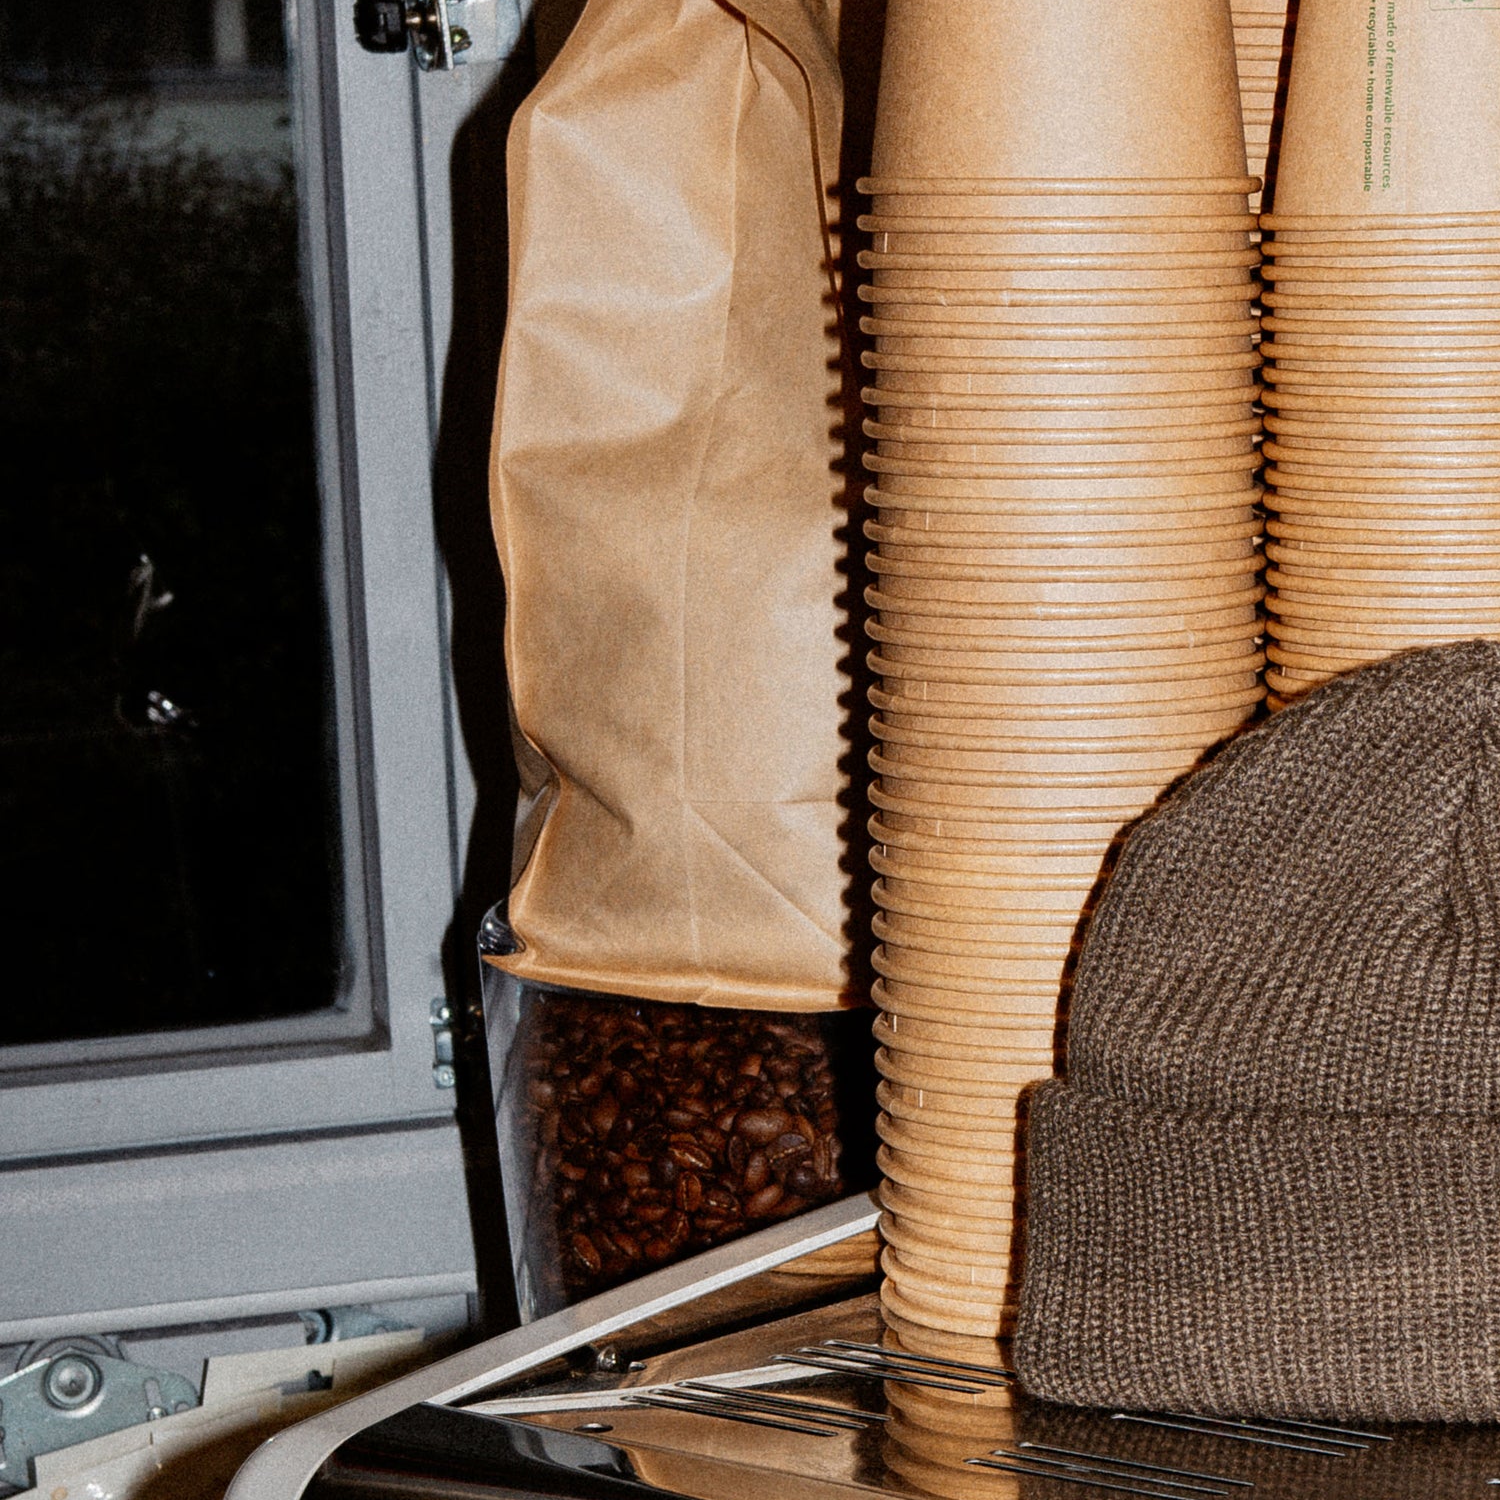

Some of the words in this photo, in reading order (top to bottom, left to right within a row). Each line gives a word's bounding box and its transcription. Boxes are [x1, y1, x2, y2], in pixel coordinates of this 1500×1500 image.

[1366, 6, 1376, 67] recyclable
[1386, 2, 1397, 36] made
[1386, 41, 1396, 53] of
[1366, 78, 1376, 111] home
[1384, 57, 1395, 123] renewable
[1363, 115, 1373, 192] compostable
[1382, 127, 1393, 192] resources.
